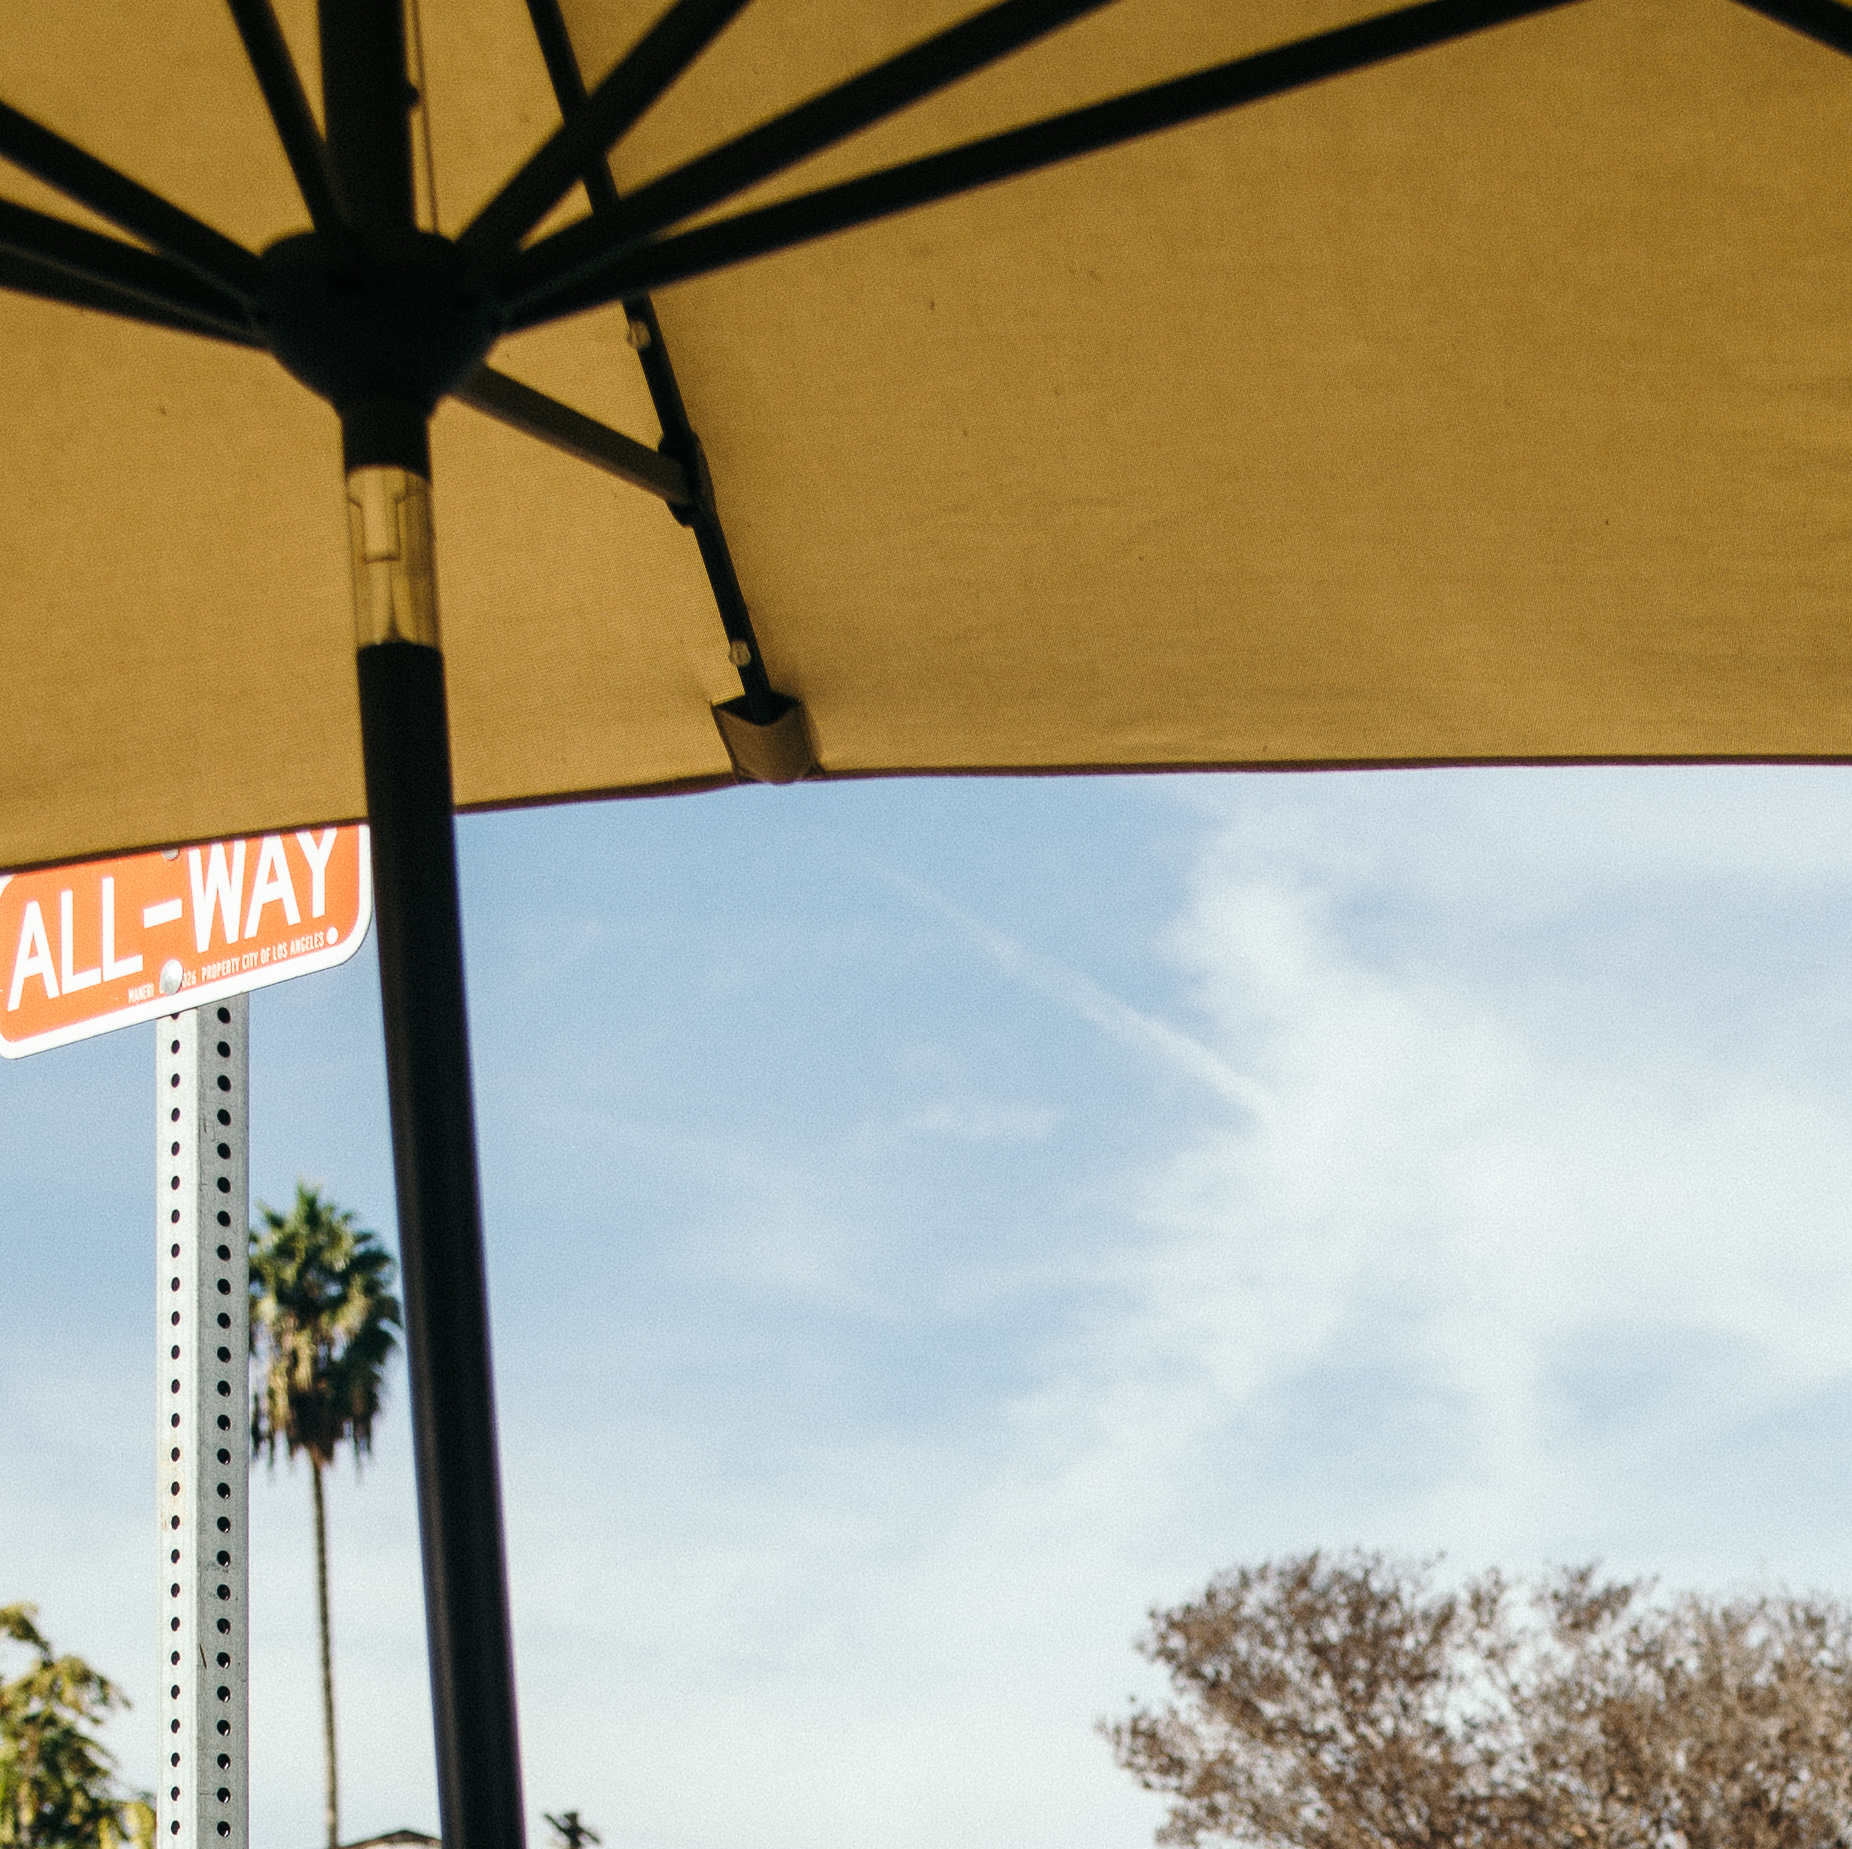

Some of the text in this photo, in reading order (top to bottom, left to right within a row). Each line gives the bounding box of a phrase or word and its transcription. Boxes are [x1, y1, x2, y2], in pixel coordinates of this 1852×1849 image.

[6, 828, 338, 1012] ALL-WAY
[201, 957, 240, 982] PROPERTY
[241, 951, 259, 970] CITY
[260, 947, 272, 964] OF
[272, 942, 288, 961] LOS
[289, 931, 325, 956] ANGELES
